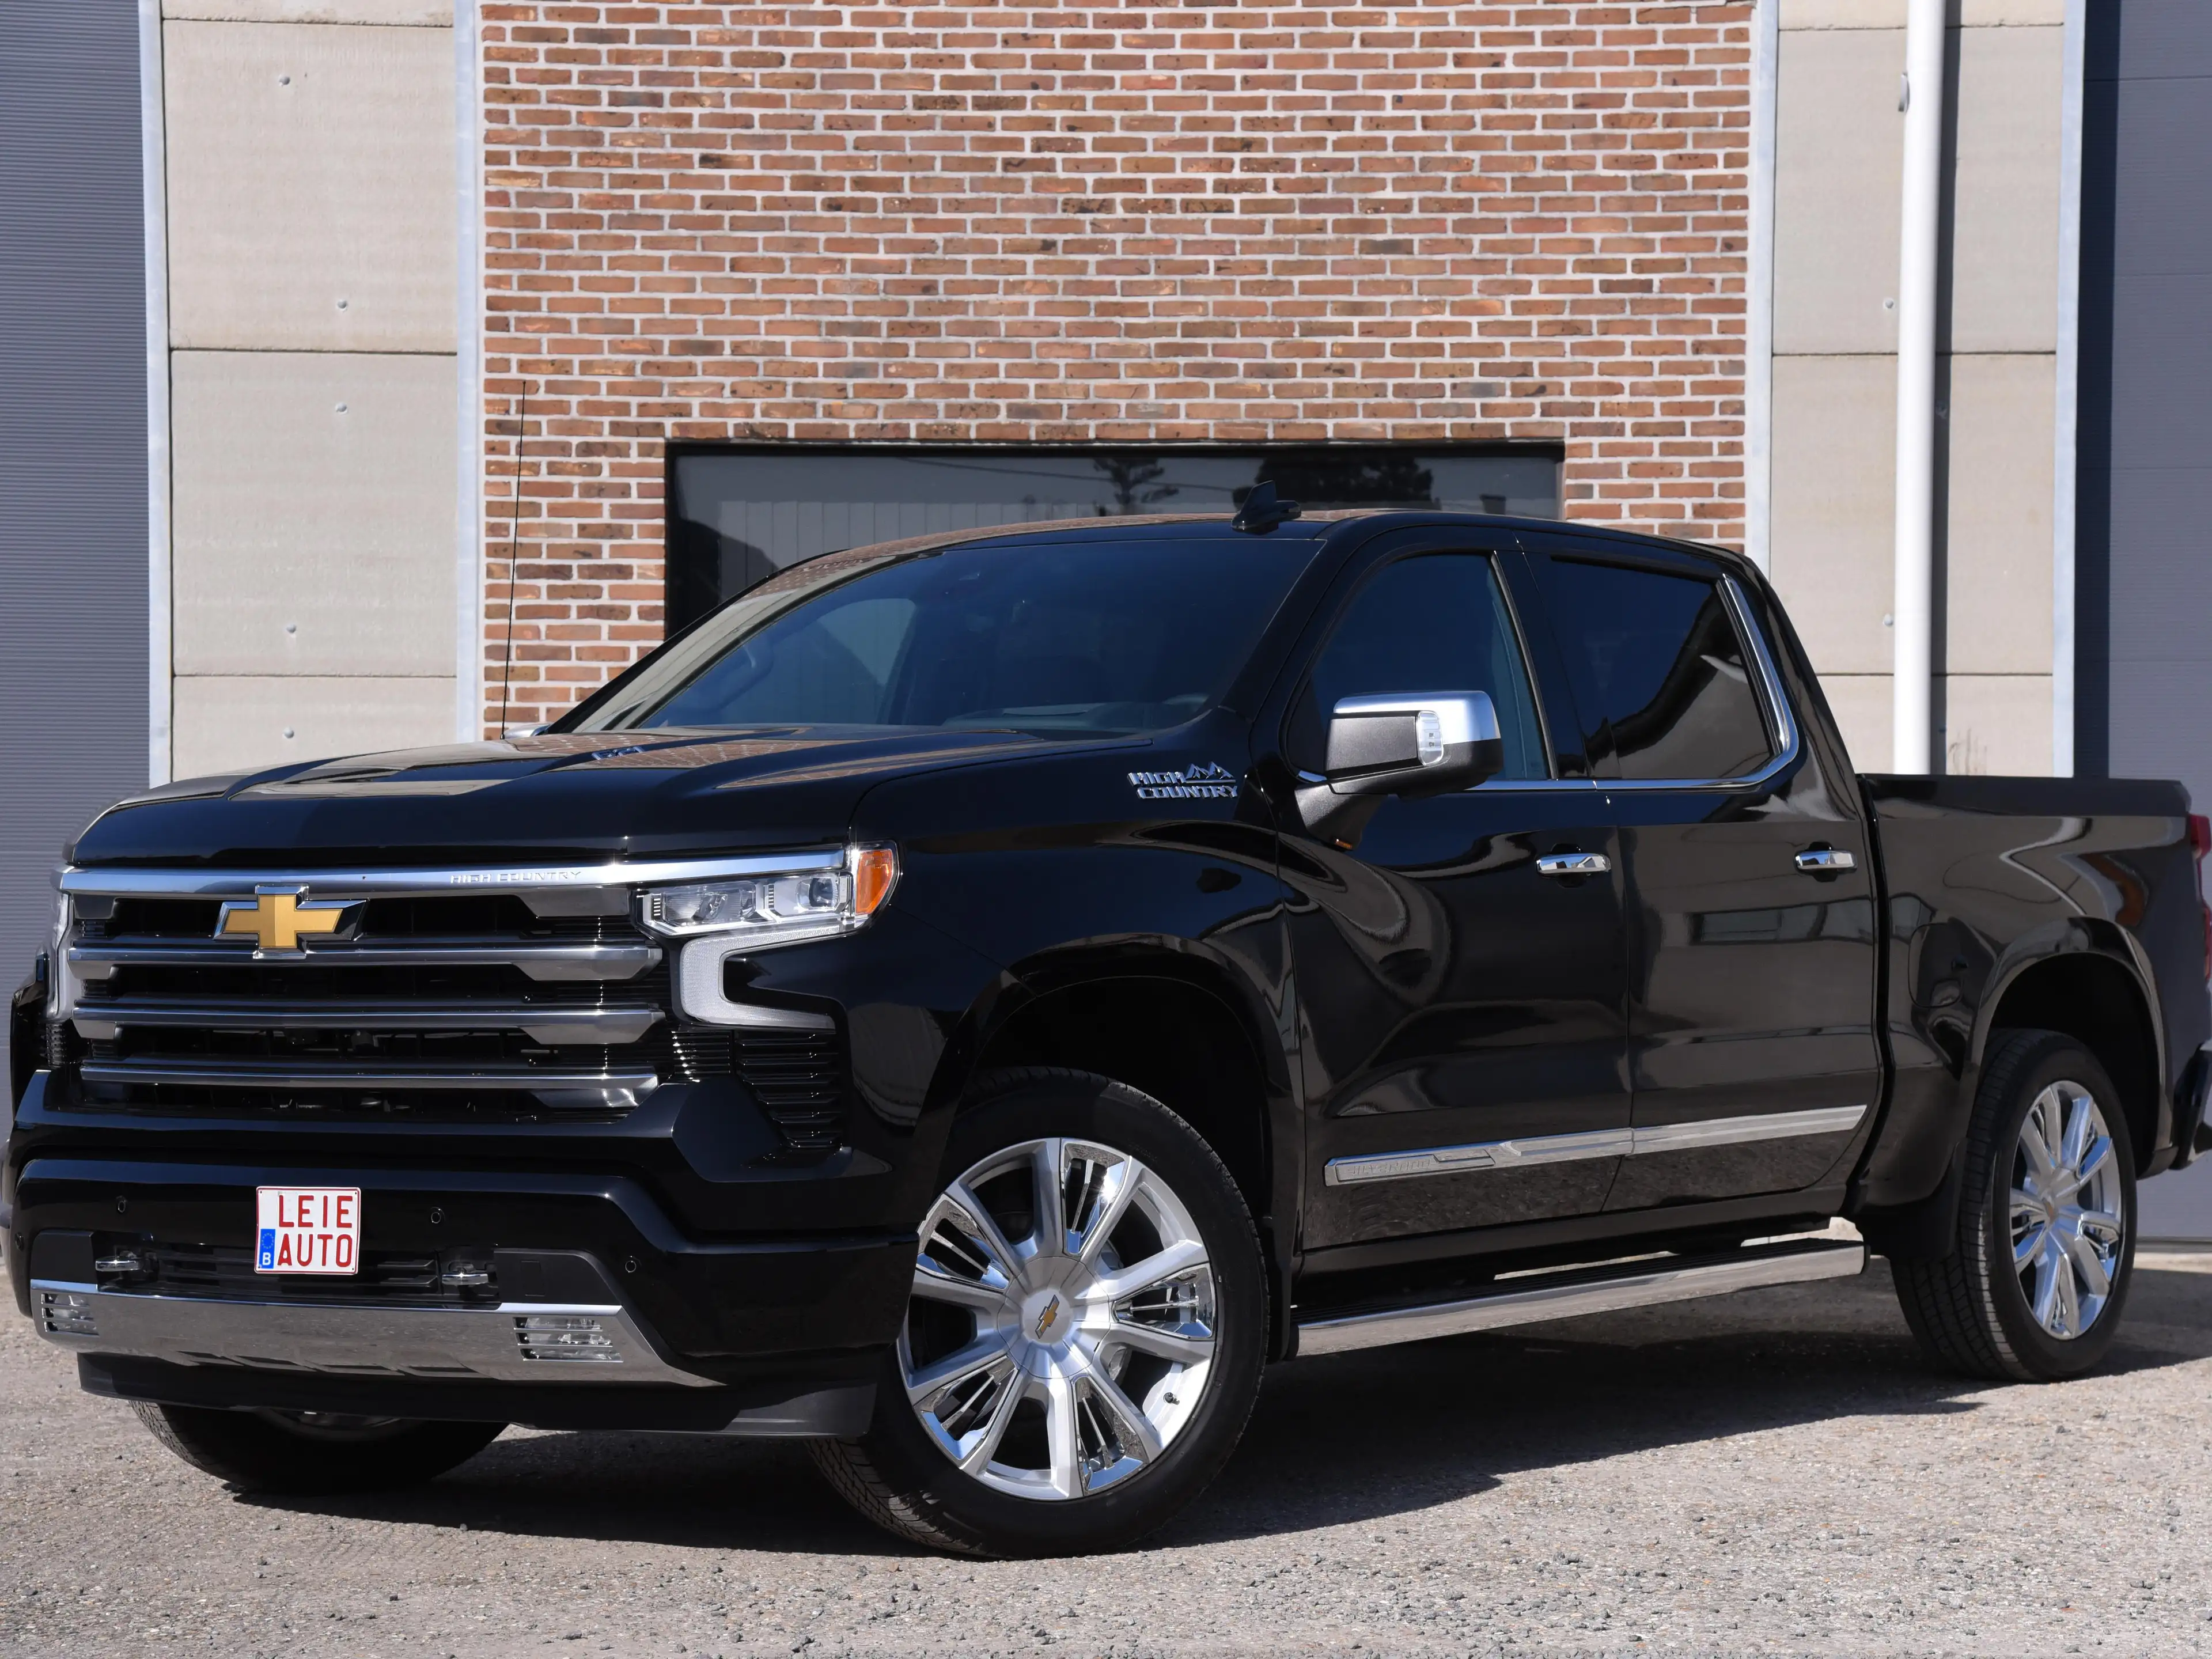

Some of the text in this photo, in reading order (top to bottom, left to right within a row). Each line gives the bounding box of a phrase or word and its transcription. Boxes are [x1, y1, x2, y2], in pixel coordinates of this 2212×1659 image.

[1127, 772, 1186, 786] HIGH
[1137, 785, 1238, 799] COUNTRY
[450, 872, 581, 884] HIGH COUNTRY
[1346, 1158, 1431, 1176] SILVERADO
[279, 1195, 353, 1228] LEIE
[277, 1233, 353, 1267] AUTO
[262, 1252, 271, 1266] B
